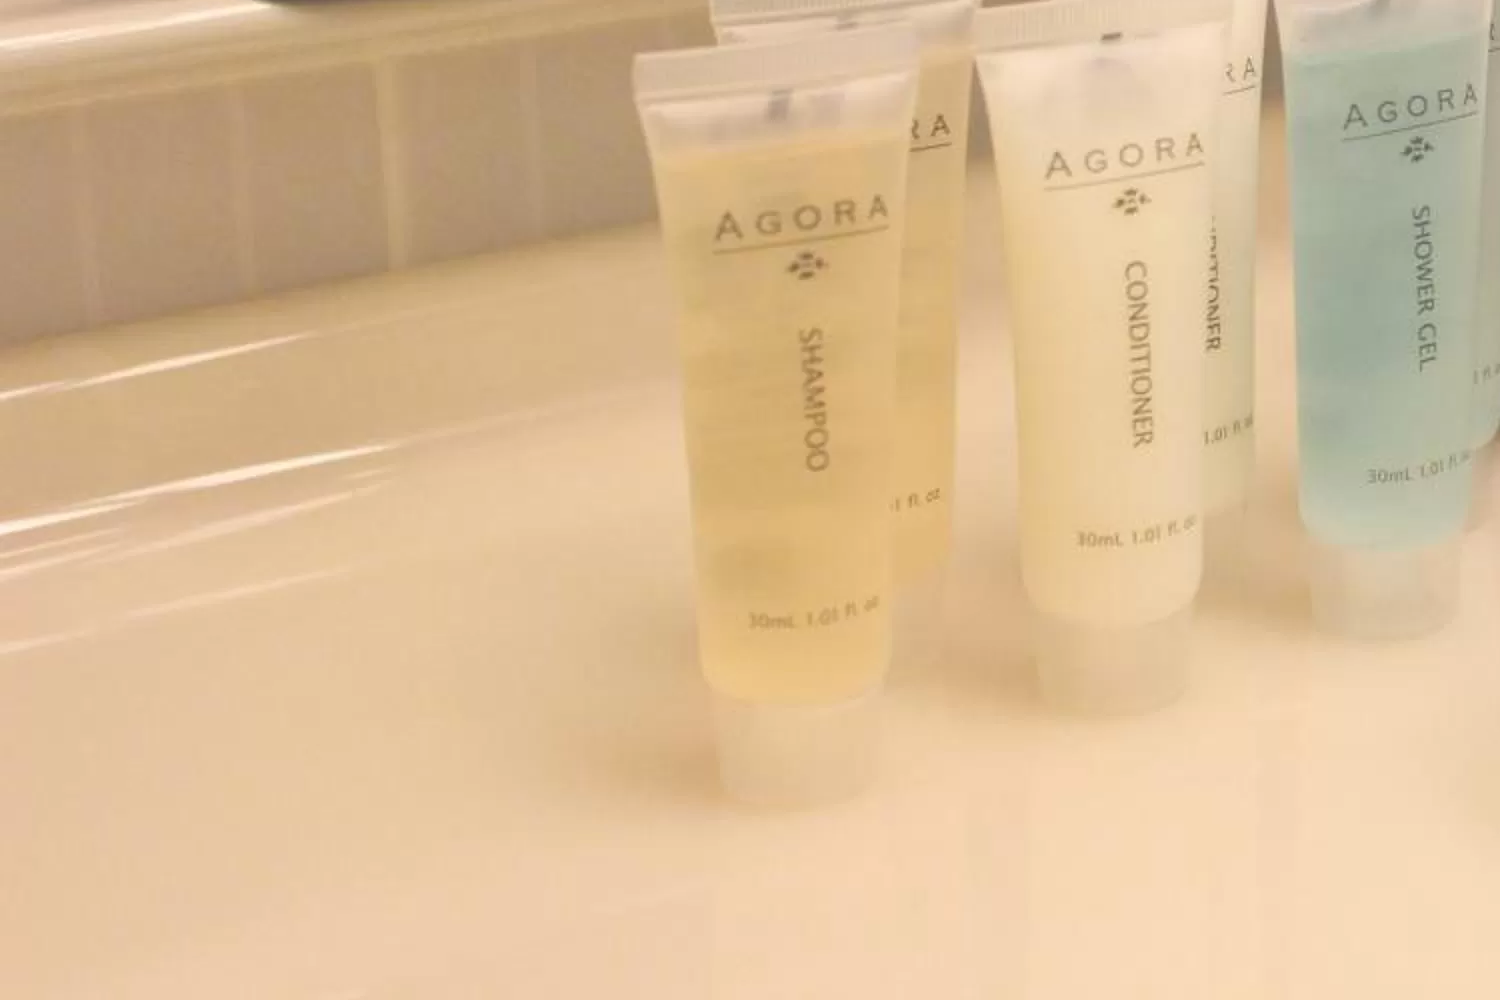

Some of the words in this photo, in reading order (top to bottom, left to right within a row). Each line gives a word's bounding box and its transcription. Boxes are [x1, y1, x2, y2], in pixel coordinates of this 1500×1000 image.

[1342, 83, 1479, 131] AGORA
[1044, 132, 1204, 180] AGORA
[714, 194, 890, 242] AGORA
[1411, 204, 1436, 317] SHOWER
[1124, 259, 1155, 449] CONDITIONER
[1416, 323, 1438, 373] GEL
[799, 327, 830, 473] SHAMPOO
